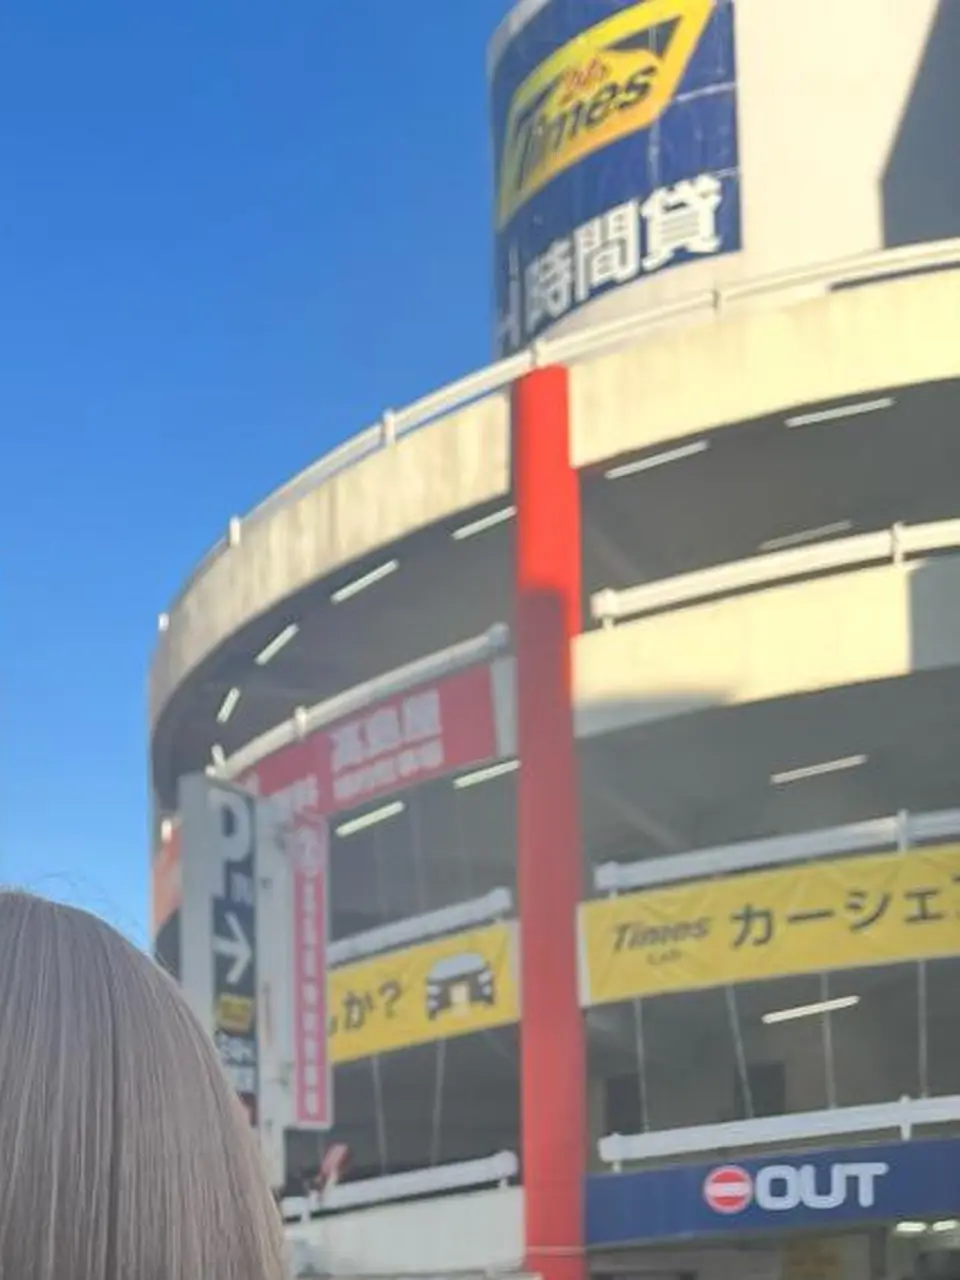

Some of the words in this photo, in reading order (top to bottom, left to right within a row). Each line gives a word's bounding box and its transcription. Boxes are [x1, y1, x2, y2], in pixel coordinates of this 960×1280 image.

[505, 173, 724, 348] 時間貸
[729, 872, 960, 948] カーシェ
[755, 1162, 889, 1211] OUT
